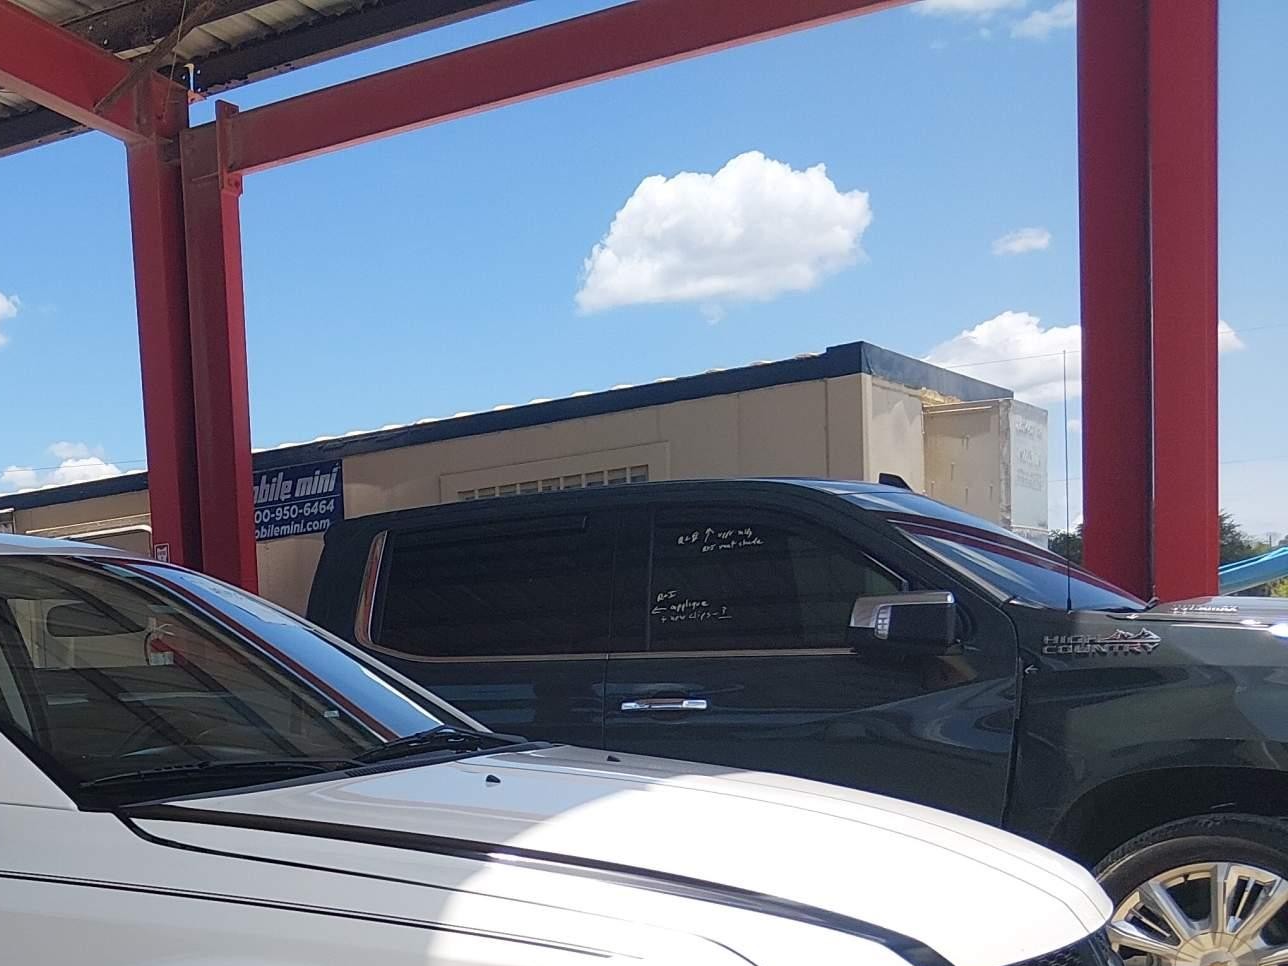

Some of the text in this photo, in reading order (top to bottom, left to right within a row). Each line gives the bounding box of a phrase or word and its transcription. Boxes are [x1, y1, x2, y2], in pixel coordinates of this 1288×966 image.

[294, 466, 339, 497] mini
[254, 499, 335, 524] 00-950-6464
[255, 519, 330, 539] obilemini.com
[1043, 635, 1098, 645] HIGH
[1043, 643, 1161, 656] COUNTRY
